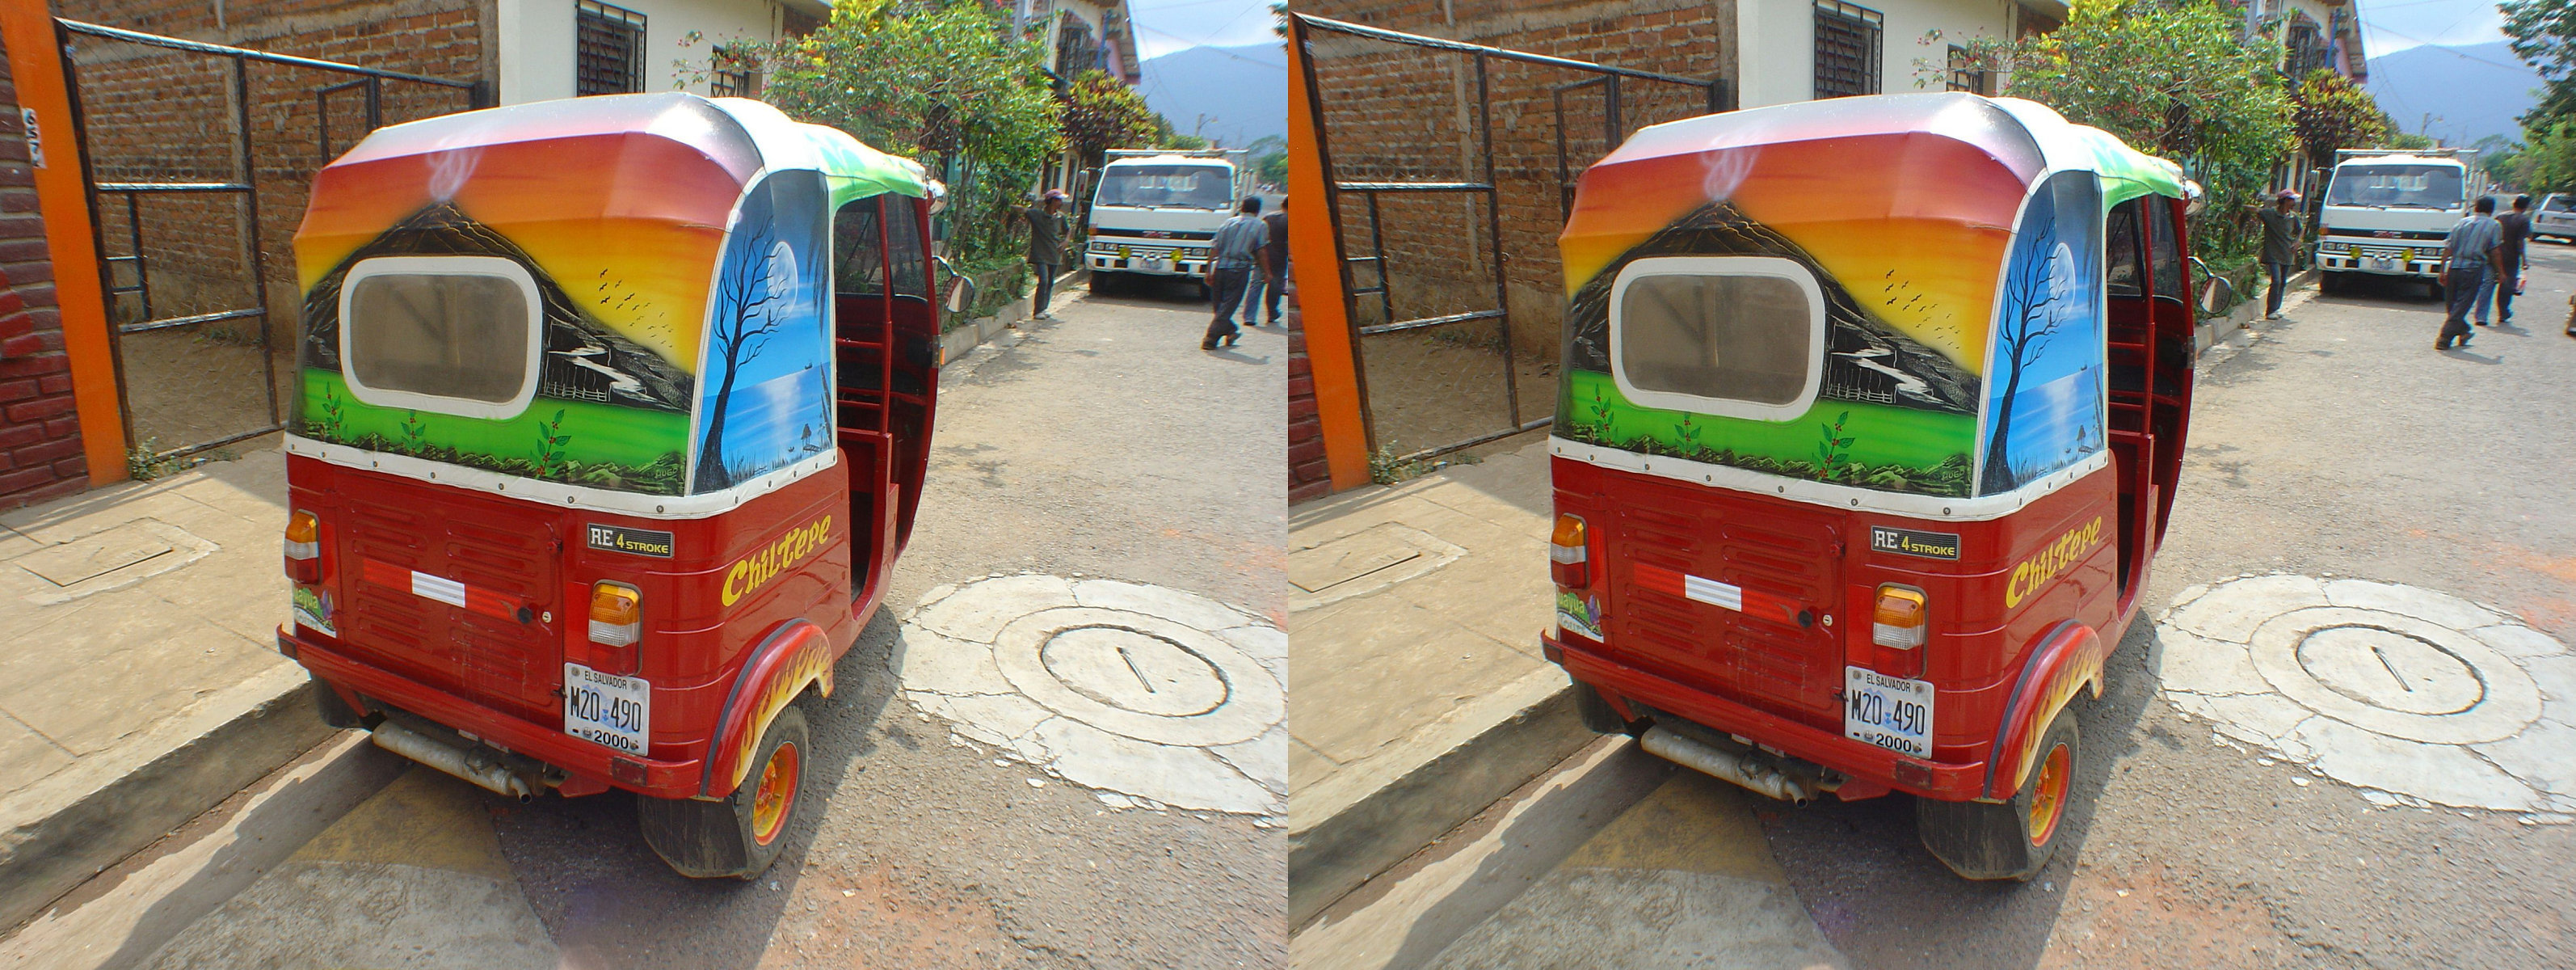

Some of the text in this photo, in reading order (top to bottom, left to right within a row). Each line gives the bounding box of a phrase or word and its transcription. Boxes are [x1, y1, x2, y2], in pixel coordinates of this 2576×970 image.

[591, 527, 669, 554] RE 4 STROKE
[1874, 529, 1955, 556] RE 4 STROKE
[584, 670, 627, 690] EL SALVADOR
[1867, 673, 1911, 693] EL SALVADOR
[594, 729, 629, 749] 2000
[1875, 732, 1912, 753] 2000
